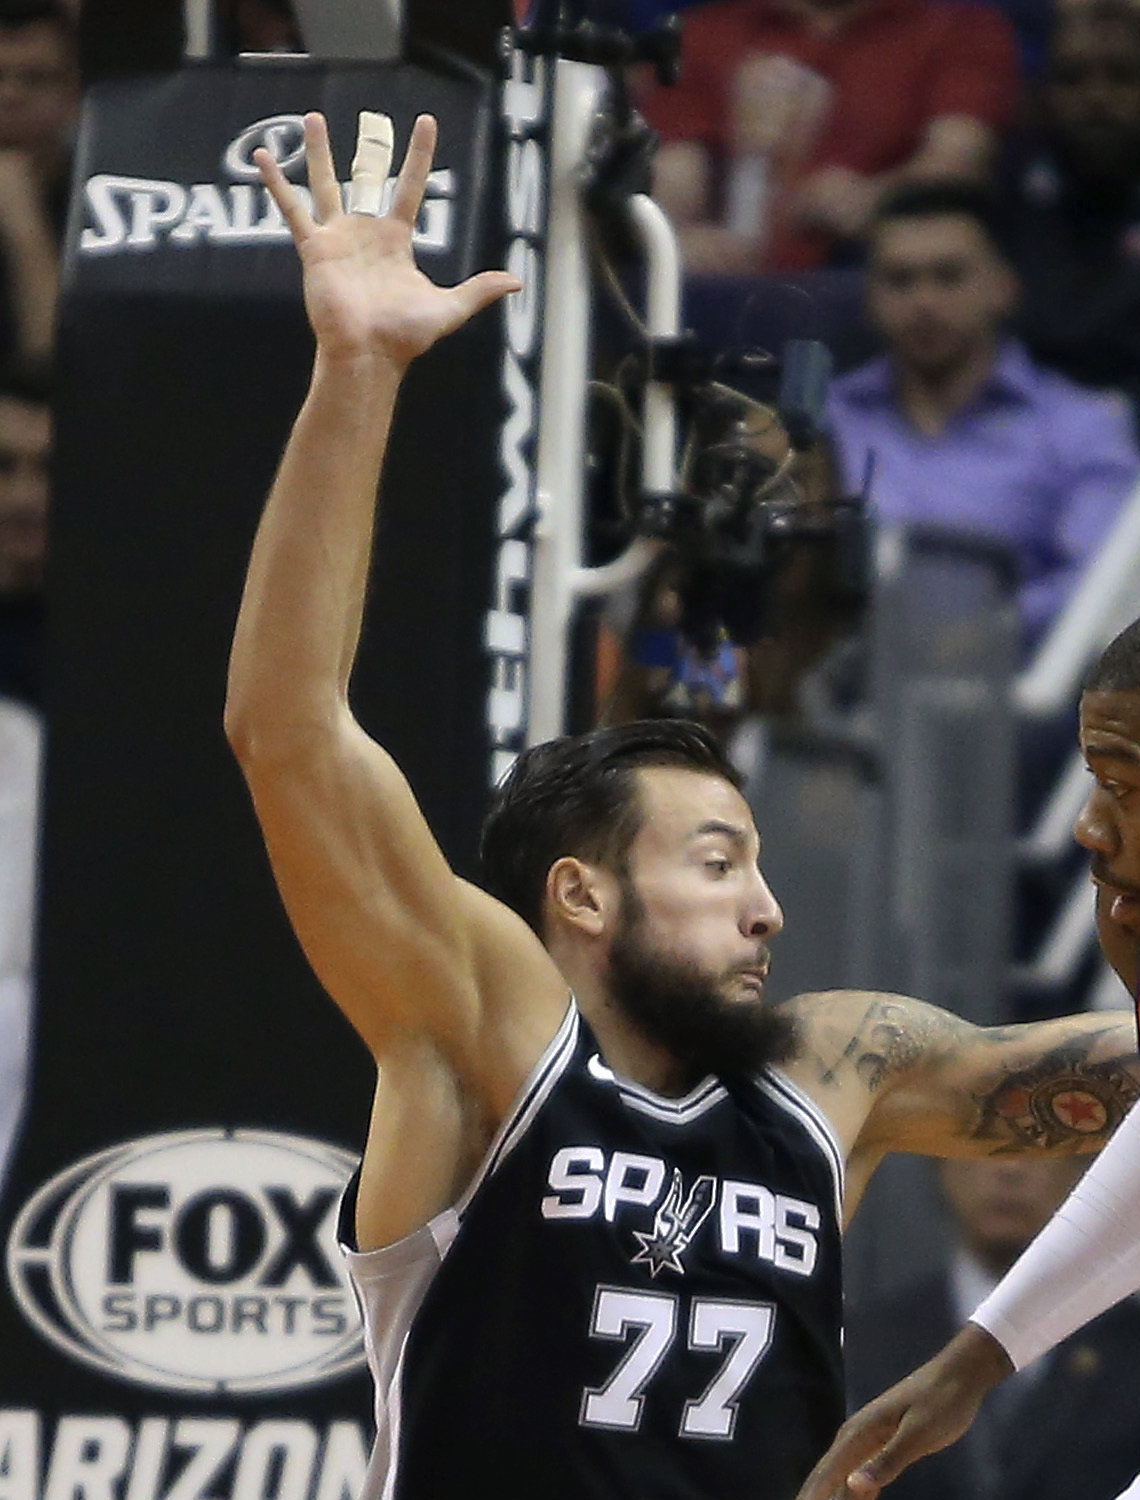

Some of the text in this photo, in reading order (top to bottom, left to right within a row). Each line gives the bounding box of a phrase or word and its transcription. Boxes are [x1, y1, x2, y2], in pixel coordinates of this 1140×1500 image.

[486, 48, 546, 788] thwest
[107, 1182, 342, 1288] FOX
[101, 1293, 346, 1336] SPORTS
[578, 1283, 777, 1440] 77
